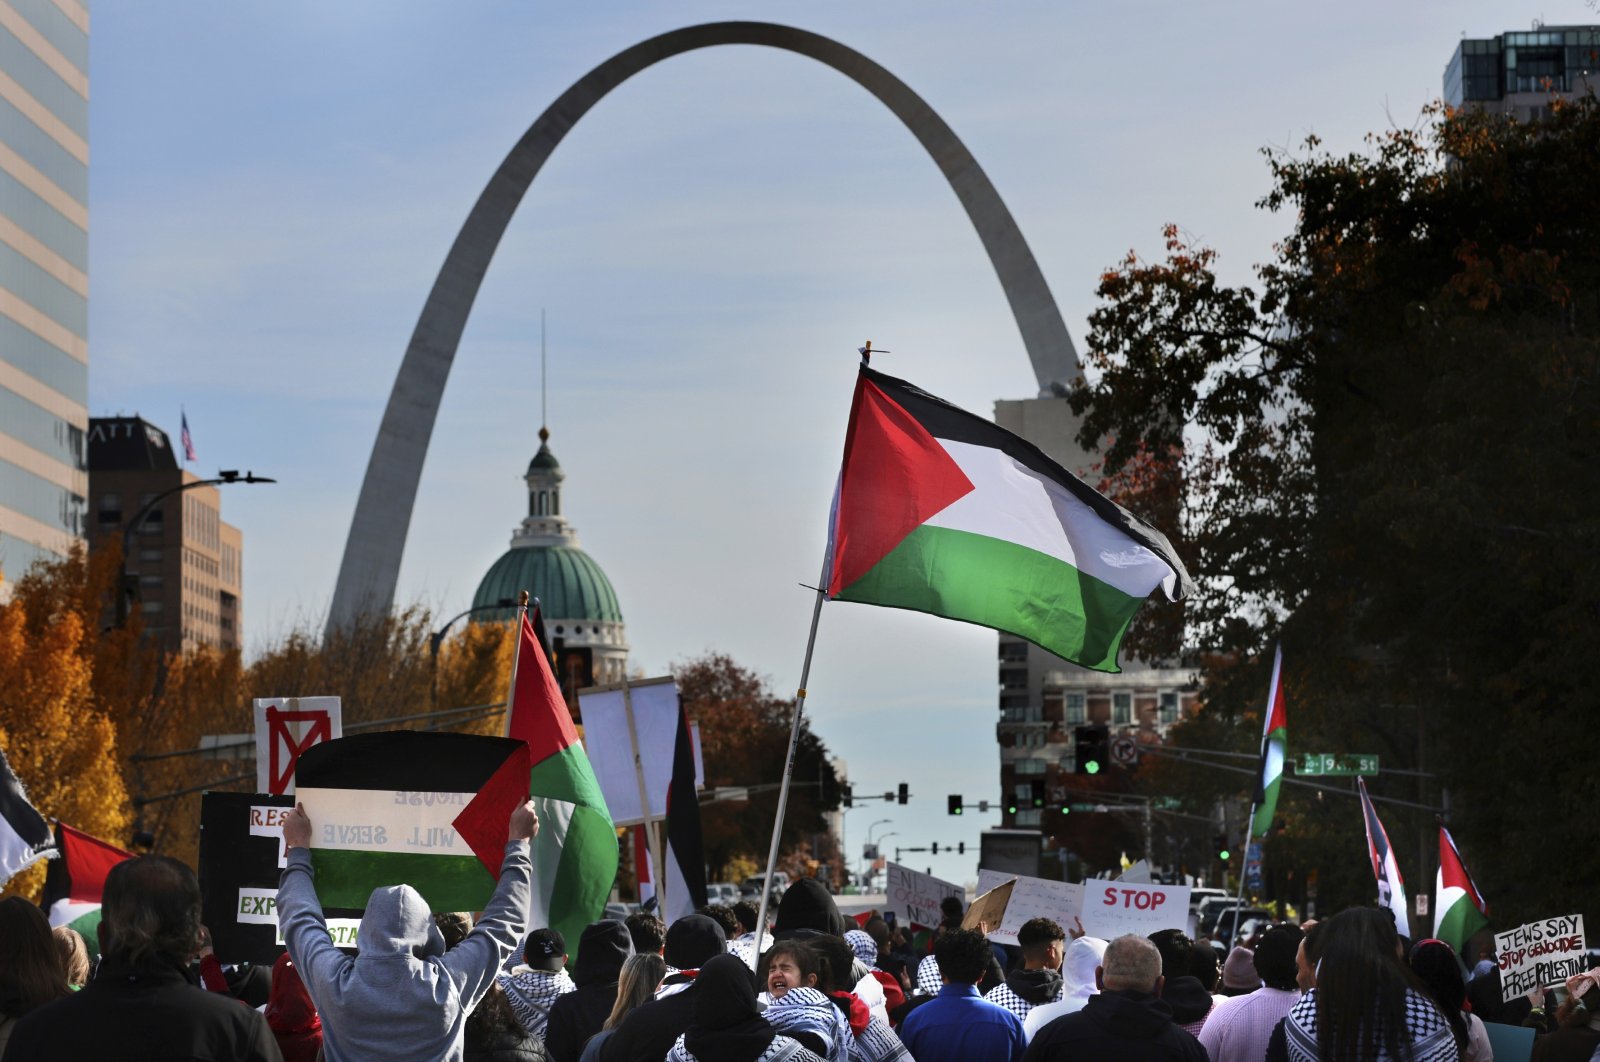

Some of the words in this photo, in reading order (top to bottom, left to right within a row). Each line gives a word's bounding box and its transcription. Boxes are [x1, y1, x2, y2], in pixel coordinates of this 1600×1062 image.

[1360, 758, 1376, 771] St
[1103, 888, 1166, 910] STOP
[1499, 923, 1543, 951] JEWS
[1546, 916, 1578, 938] SAY
[1499, 948, 1527, 970] STOP
[1527, 935, 1582, 958] GENOCIDE
[1502, 967, 1535, 999] FREE
